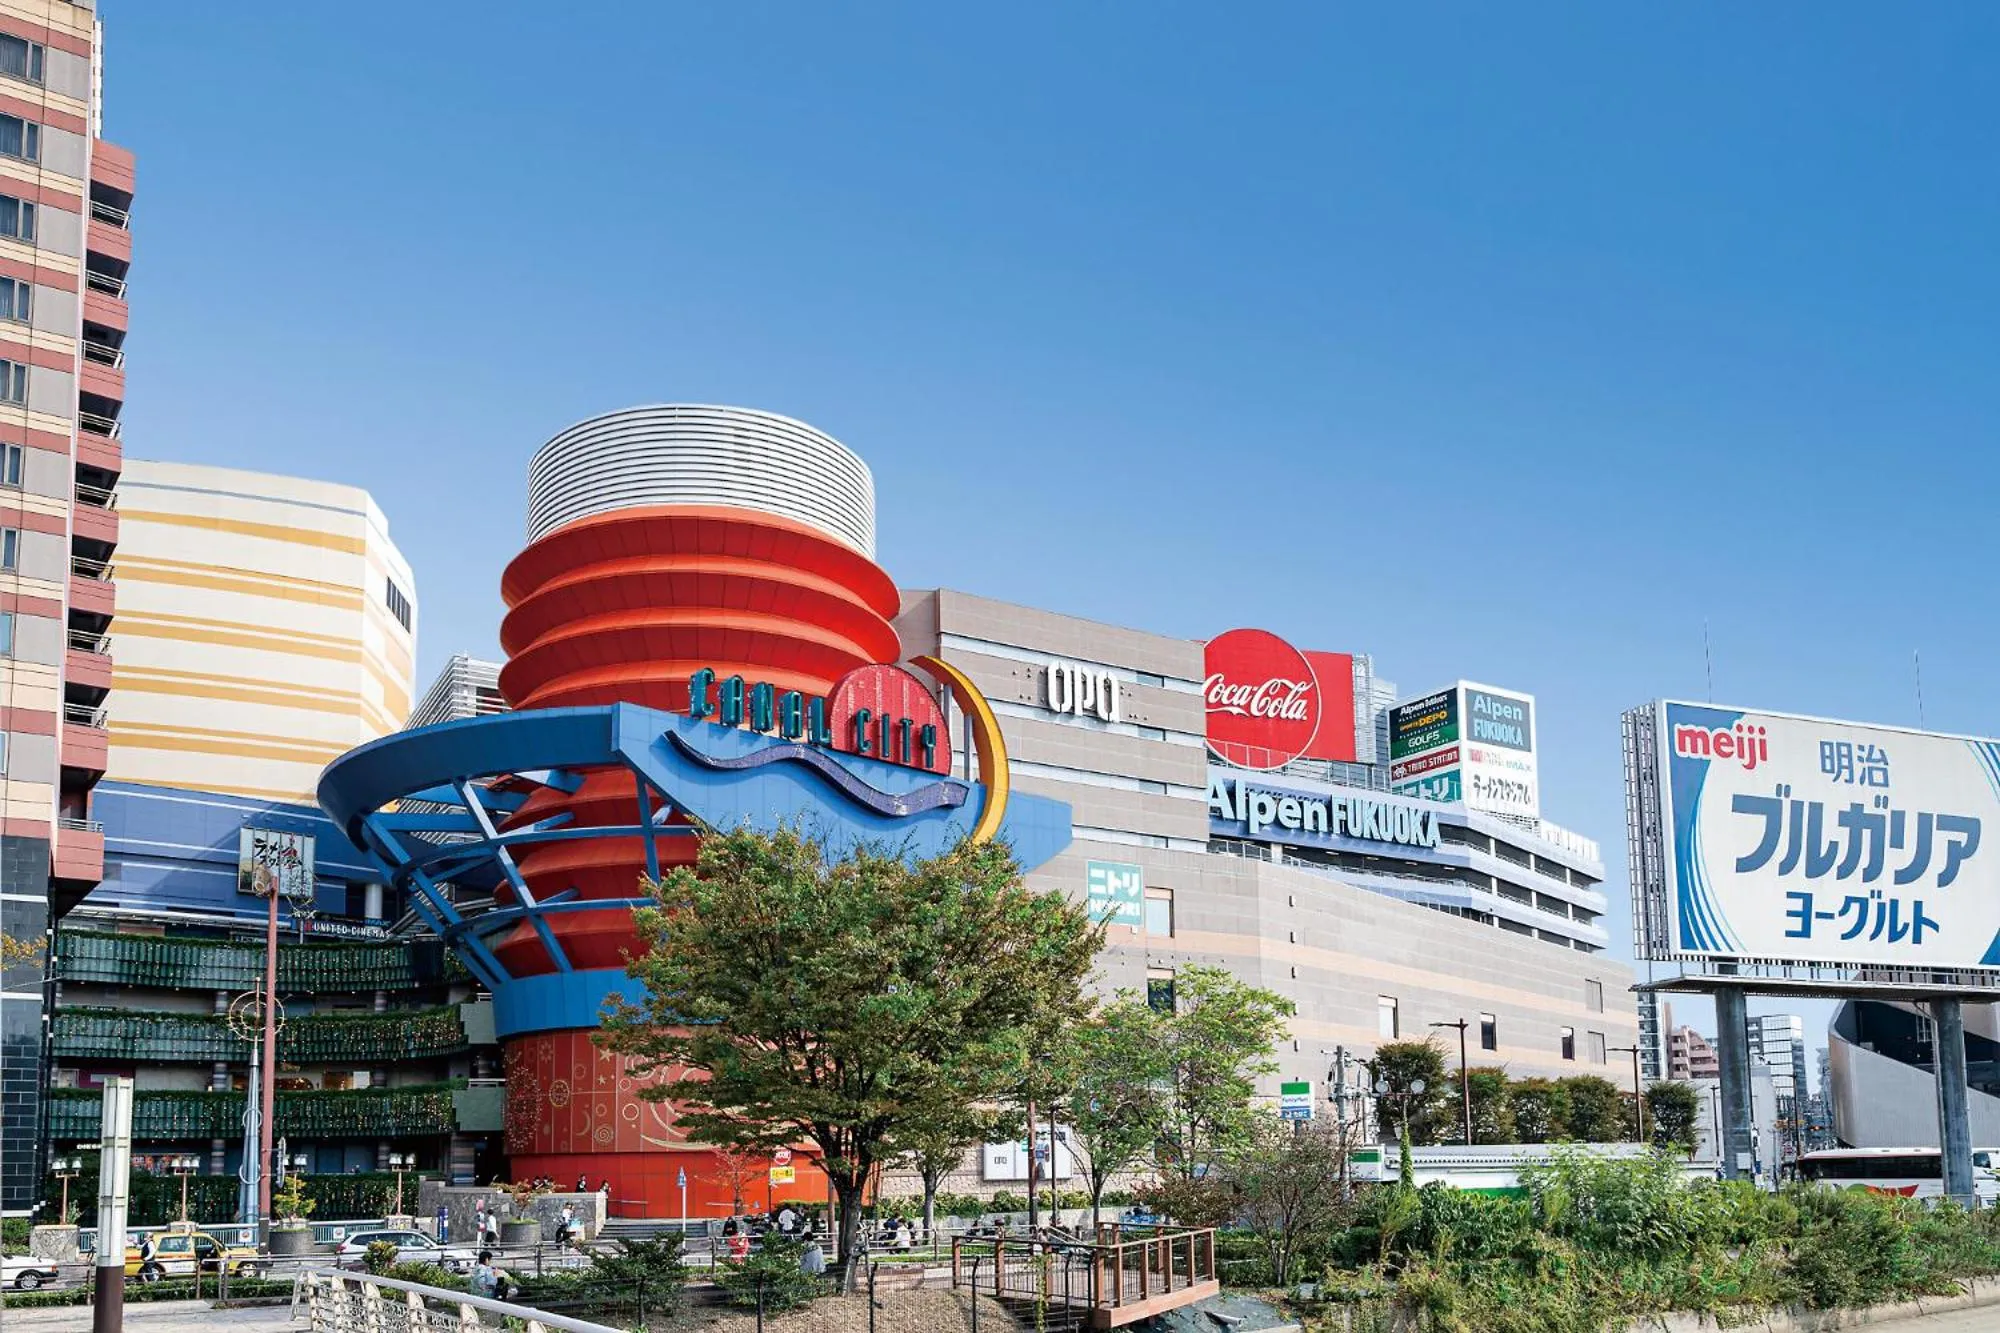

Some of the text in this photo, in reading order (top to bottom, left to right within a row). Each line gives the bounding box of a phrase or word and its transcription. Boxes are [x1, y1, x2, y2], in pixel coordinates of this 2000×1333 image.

[689, 667, 936, 768] CANAL CITY
[1201, 673, 1313, 719] Coca-Cola
[1473, 695, 1523, 721] Alpen
[1474, 719, 1525, 747] FUKUOKA
[1677, 723, 1768, 770] meiji
[1819, 740, 1890, 788] 明治
[1208, 777, 1442, 848] Alpen FUKUOKA
[1731, 783, 1981, 888] ブルガリア
[1089, 868, 1139, 897] ニトリ
[313, 922, 348, 934] UNITED
[1785, 890, 1940, 945] ヨーグルト
